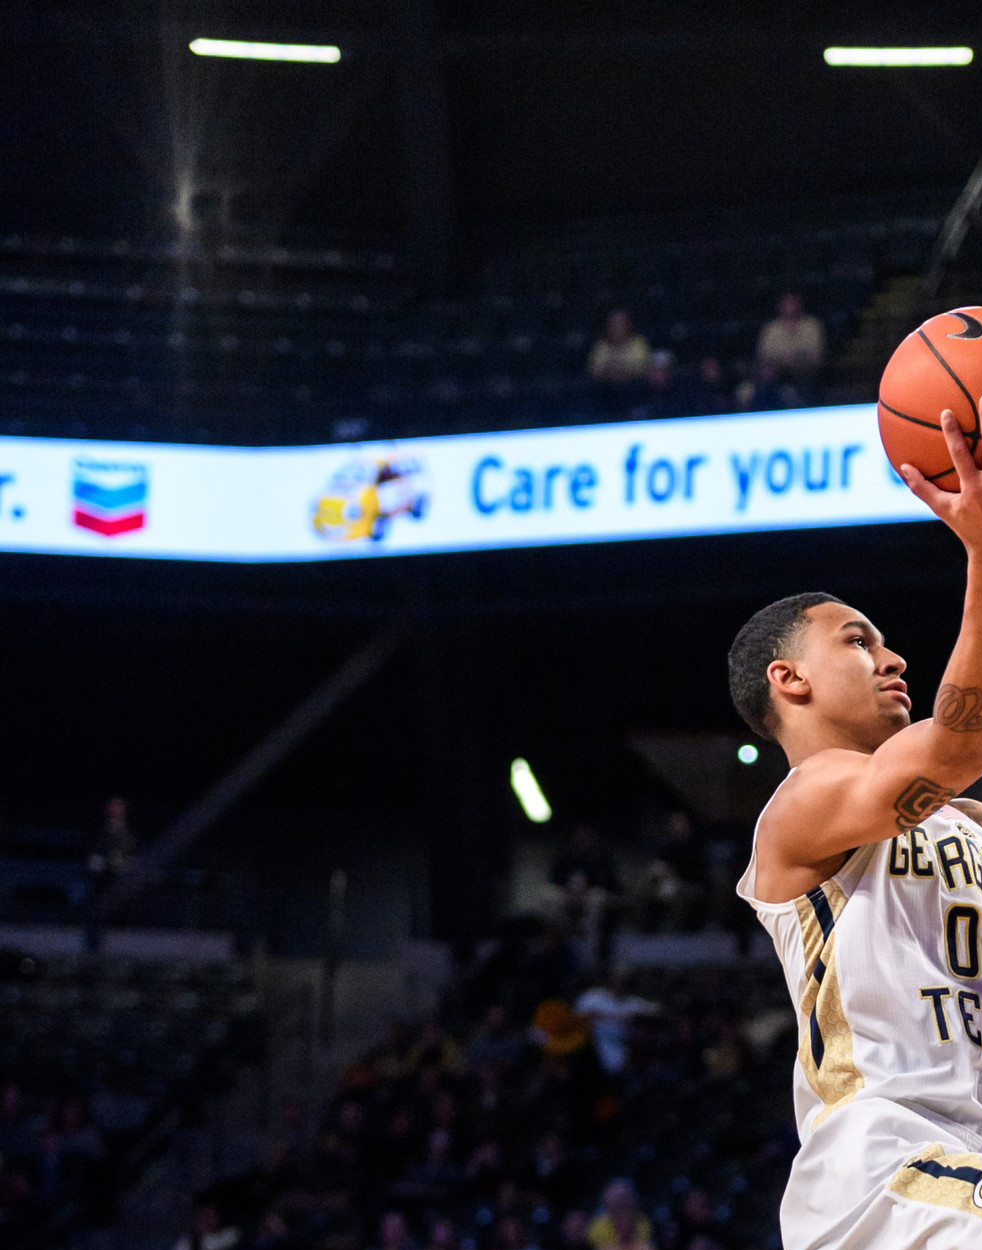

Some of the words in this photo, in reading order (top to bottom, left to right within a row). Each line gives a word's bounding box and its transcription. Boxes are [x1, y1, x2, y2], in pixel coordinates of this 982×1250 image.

[471, 454, 599, 516] Care
[623, 443, 706, 505] for
[730, 443, 863, 513] your
[944, 903, 981, 980] 0
